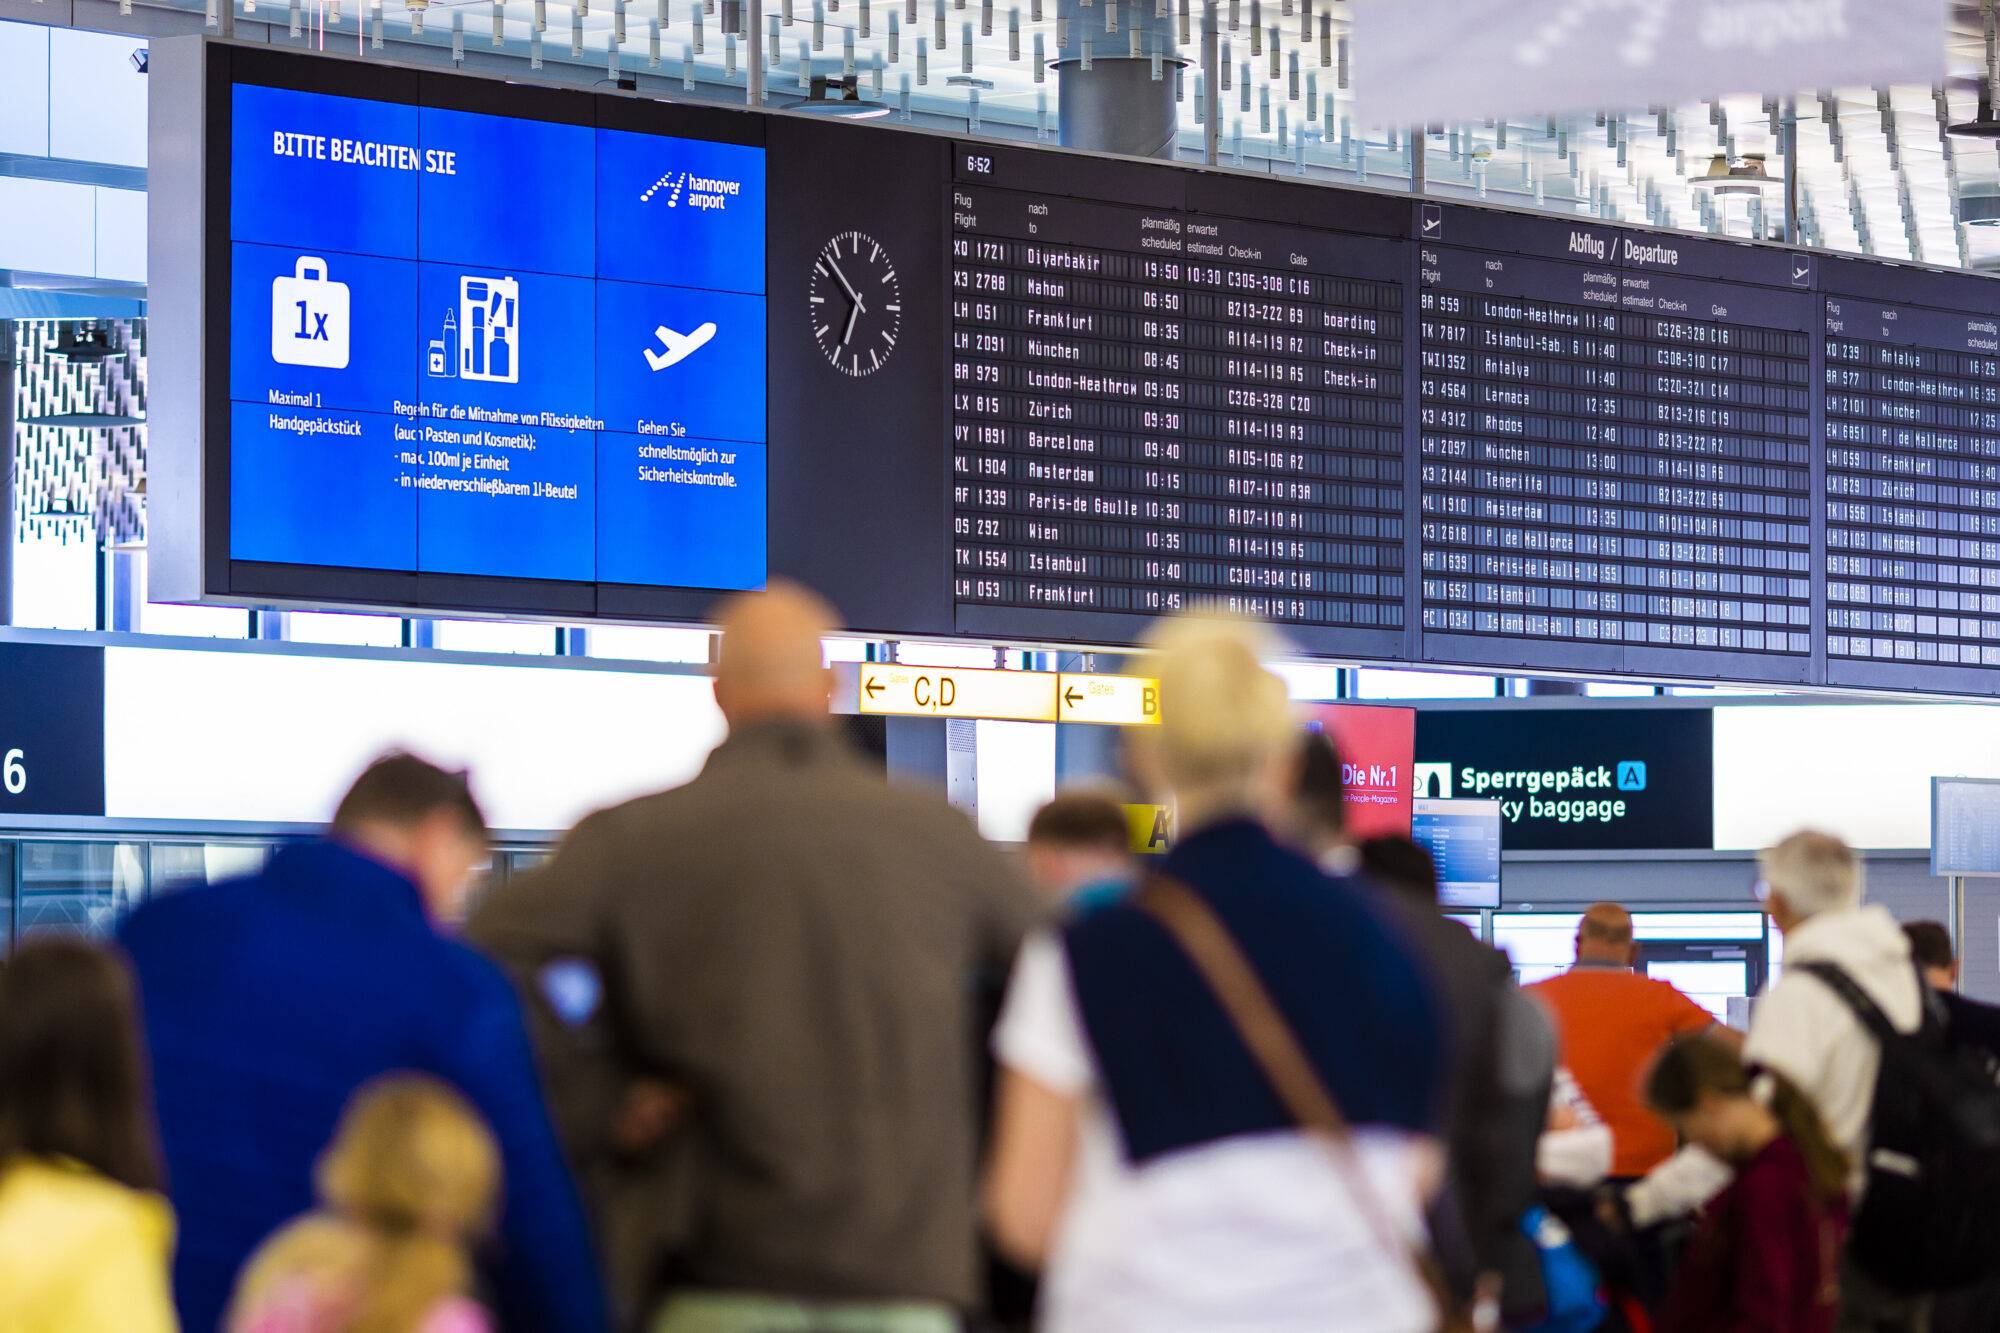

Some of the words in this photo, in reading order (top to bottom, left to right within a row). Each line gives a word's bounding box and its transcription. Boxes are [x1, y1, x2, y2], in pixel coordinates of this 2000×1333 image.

[274, 131, 326, 160] BITTE
[331, 138, 420, 171] BEACHTEN
[426, 149, 456, 175] SIE
[968, 156, 991, 173] 6:52
[689, 172, 740, 195] hannover
[688, 193, 725, 211] airport
[954, 193, 972, 208] Flug
[1028, 204, 1048, 216] nach
[1142, 216, 1180, 234] planmäßig
[1187, 224, 1218, 236] erwartet
[954, 212, 976, 228] Flight
[1029, 222, 1037, 234] to
[1142, 236, 1181, 250] scheduled
[1187, 242, 1223, 255] estimated
[1228, 245, 1262, 260] Check-in
[1290, 253, 1308, 266] Gate
[1569, 231, 1604, 259] Abflug
[1624, 239, 1678, 266] Departure
[954, 240, 968, 257] XQ
[976, 243, 1004, 261] 1721
[1028, 248, 1100, 271] Diyarbakir
[1144, 262, 1178, 280] 19:50
[1187, 267, 1221, 285] 10:30
[1228, 272, 1283, 292] C305-308
[1290, 279, 1310, 295] C16
[1422, 250, 1437, 265] Flug
[1485, 259, 1502, 271] nach
[1583, 271, 1617, 287] planmäßig
[1622, 278, 1650, 290] erwartet
[954, 271, 968, 288] X3
[976, 273, 1005, 292] 2788
[1028, 279, 1064, 298] Mahon
[1144, 292, 1178, 310] 06:50
[1228, 301, 1283, 321] B213-222
[1290, 308, 1303, 324] B9
[1324, 312, 1376, 335] boarding
[1422, 269, 1441, 283] Flight
[1486, 277, 1493, 288] to
[1583, 290, 1617, 303] scheduled
[1622, 296, 1654, 307] estimated
[1658, 298, 1687, 312] Check-in
[1712, 304, 1727, 317] Gate
[294, 300, 329, 341] 1x
[954, 302, 968, 318] LH
[976, 304, 997, 321] 051
[1028, 310, 1092, 331] Frankfurt
[1144, 322, 1179, 340] 08:35
[1228, 331, 1283, 351] A114-119
[1290, 337, 1303, 353] A2
[1324, 341, 1376, 360] Check-in
[1421, 294, 1433, 310] BA
[1440, 297, 1460, 313] 959
[1484, 302, 1578, 327] London-Heathrow
[1586, 314, 1615, 331] 11:40
[1658, 322, 1705, 342] C326-328
[1711, 329, 1728, 344] C16
[1827, 302, 1840, 315] Flug
[1882, 310, 1897, 320] nach
[1968, 321, 1997, 335] planmäßig
[1827, 318, 1843, 332] Flight
[1883, 326, 1889, 336] to
[1968, 338, 1998, 350] scheduled
[954, 333, 968, 350] LH
[976, 335, 1005, 353] 2091
[1028, 340, 1079, 360] München
[1144, 352, 1179, 370] 08:45
[1228, 361, 1283, 380] A114-119
[1290, 367, 1304, 382] A5
[1324, 370, 1377, 389] Check-in
[1422, 323, 1434, 339] TK
[1440, 325, 1466, 342] 7817
[1485, 330, 1565, 353] Istanbul-Sab.
[1586, 342, 1615, 359] 11:40
[1658, 350, 1705, 369] C308-310
[1711, 356, 1729, 372] C17
[1842, 344, 1860, 360] 239
[1881, 349, 1920, 367] Antalya
[1970, 359, 1996, 376] 16:25
[269, 389, 312, 407] Maximal
[316, 393, 322, 408] 1
[954, 364, 969, 380] BA
[976, 366, 999, 383] 979
[1028, 371, 1137, 396] London-Heathrow
[1144, 382, 1179, 400] 09:05
[1228, 390, 1283, 410] C326-328
[1290, 396, 1310, 412] C20
[1826, 369, 1837, 384] BA
[1842, 371, 1860, 386] 977
[1882, 375, 1964, 398] London-Heathrow
[1970, 385, 1996, 402] 16:35
[270, 414, 362, 436] Handgepäckstück
[394, 400, 429, 421] Regeln
[432, 402, 448, 418] für
[450, 404, 466, 419] die
[468, 406, 518, 423] Mitnahme
[521, 414, 538, 425] von
[541, 412, 604, 434] Flüssigkeiten
[638, 419, 668, 436] Gehen
[670, 422, 686, 437] Sie
[954, 395, 969, 411] LX
[976, 397, 999, 414] 815
[1028, 402, 1072, 420] Zürich
[1144, 412, 1179, 430] 09:30
[1228, 420, 1283, 439] A114-119
[1290, 426, 1303, 441] A3
[426, 426, 460, 444] Pasten
[462, 430, 482, 446] und
[484, 432, 536, 451] Kosmetik):
[638, 444, 718, 466] schnellstmöglich
[720, 452, 736, 464] zur
[954, 426, 969, 442] VY
[978, 428, 1005, 445] 1891
[1029, 432, 1094, 453] Barcelona
[1144, 442, 1180, 460] 09:40
[1228, 450, 1283, 468] A105-106
[1290, 455, 1304, 470] A2
[428, 450, 460, 467] 100ml
[461, 452, 472, 472] je
[474, 454, 509, 471] Einheit
[638, 466, 737, 487] Sicherheitskontrolle.
[401, 472, 411, 487] in
[413, 473, 530, 498] wiederverschließbarem
[954, 457, 969, 473] KL
[978, 459, 1007, 476] 1904
[1029, 463, 1094, 483] Amsterdam
[1145, 472, 1180, 490] 10:15
[1228, 479, 1283, 498] A107-110
[1290, 484, 1310, 500] A3A
[956, 581, 970, 597] LH
[978, 582, 1000, 599] 053
[1030, 585, 1094, 604] Frankfurt
[914, 676, 956, 712] C,D
[1088, 681, 1115, 695] Gates
[1143, 687, 1157, 715] B
[4, 748, 26, 794] 6
[1342, 764, 1366, 786] Die
[1370, 764, 1396, 786] Nr.1
[1461, 765, 1611, 793] Sperrgepäck
[1623, 766, 1640, 785] A
[1530, 796, 1626, 823] baggage
[1148, 810, 1170, 848] A
